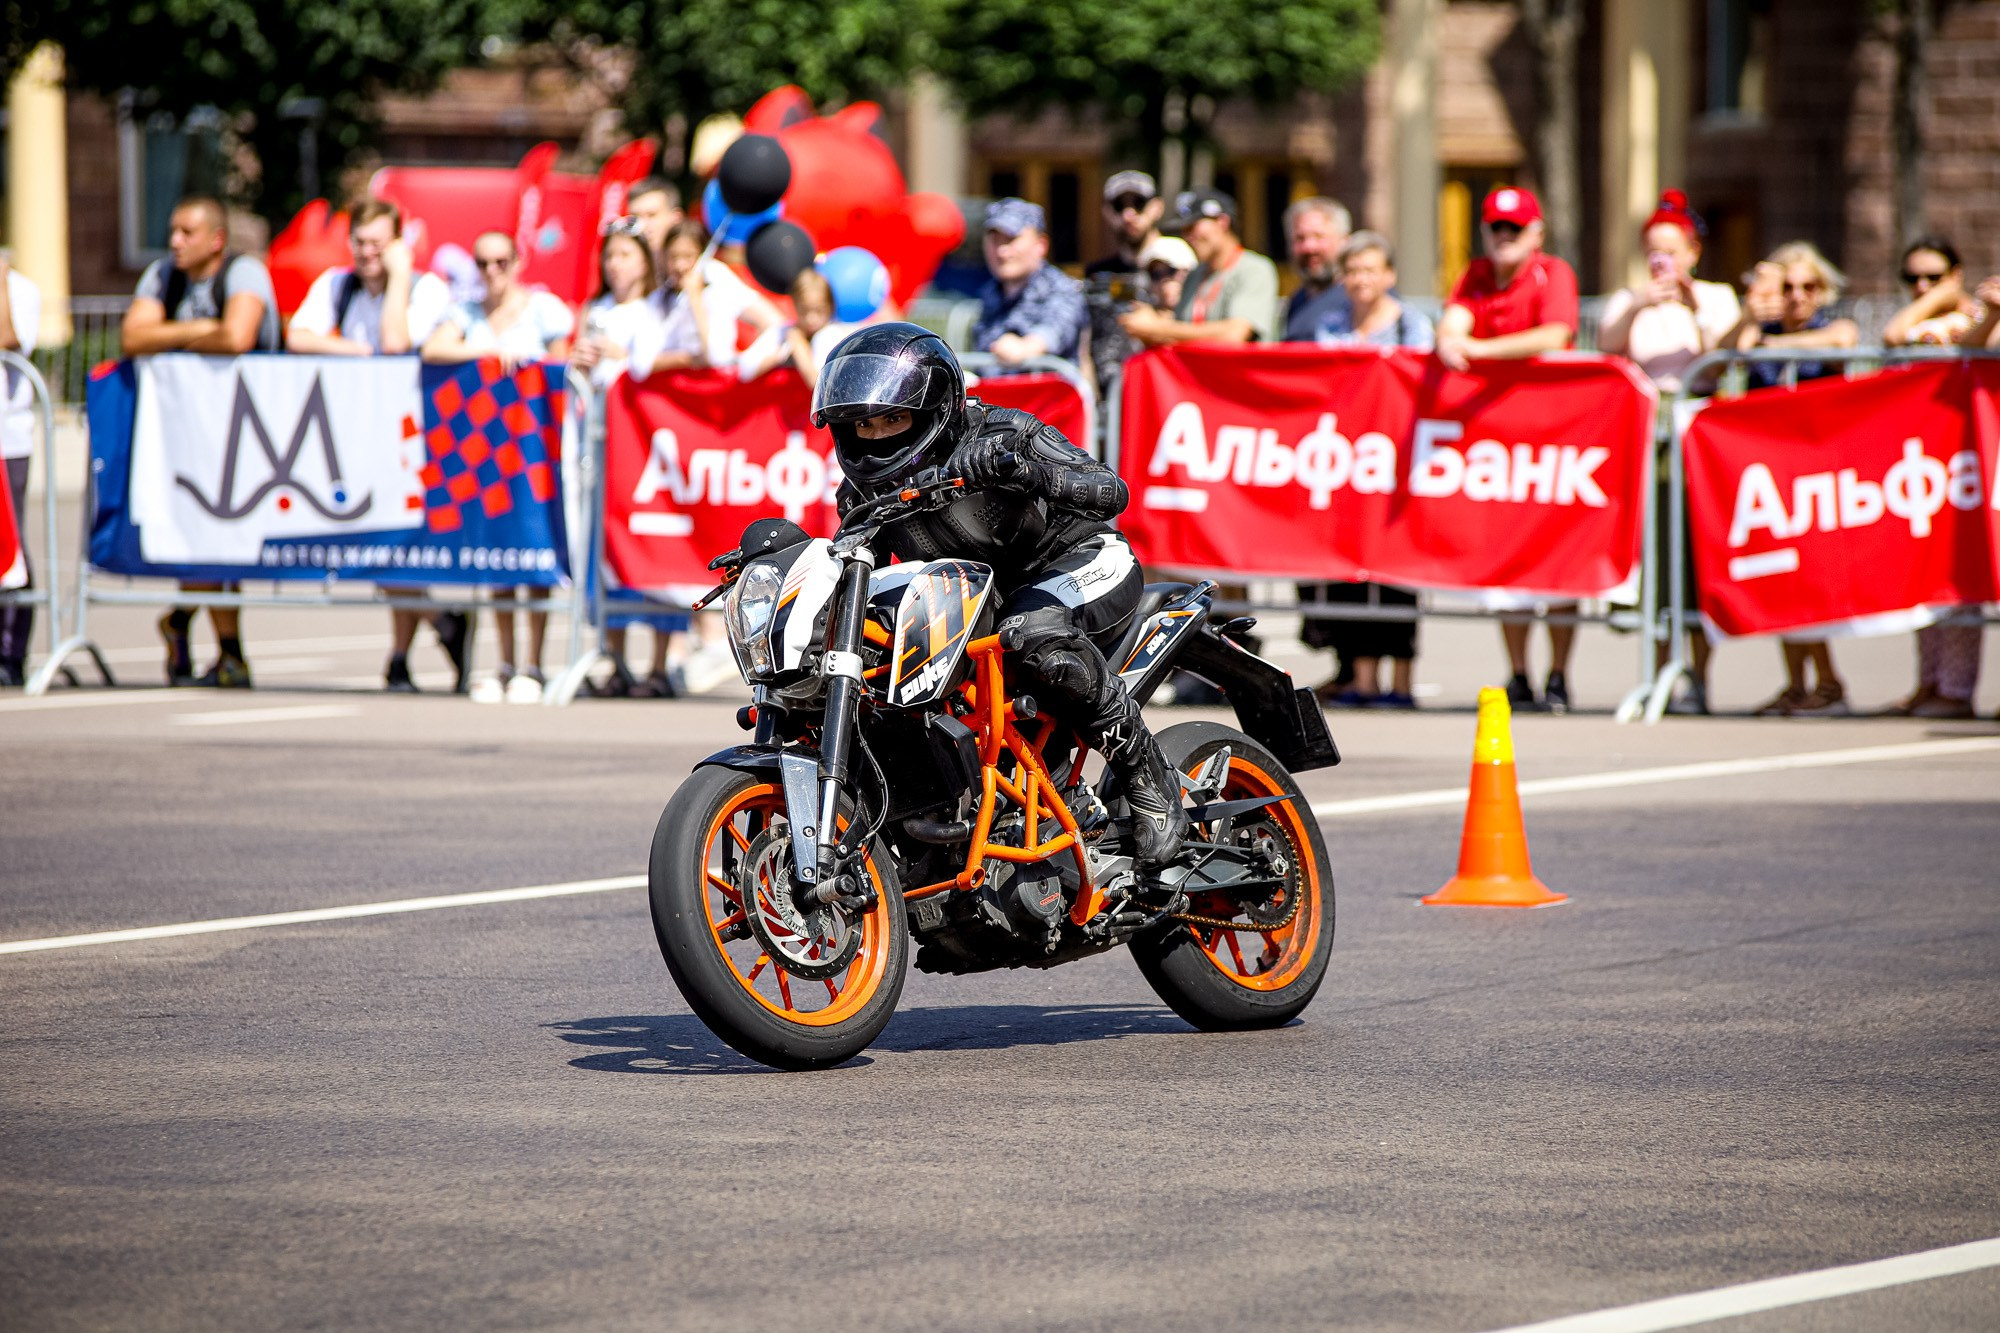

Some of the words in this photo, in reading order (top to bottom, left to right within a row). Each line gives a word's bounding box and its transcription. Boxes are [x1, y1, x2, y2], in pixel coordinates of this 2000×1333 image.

[1147, 401, 1397, 510] Альфа
[1408, 418, 1609, 507] Банк
[1727, 438, 1983, 546] Альфа
[459, 546, 557, 572] РОССИИ
